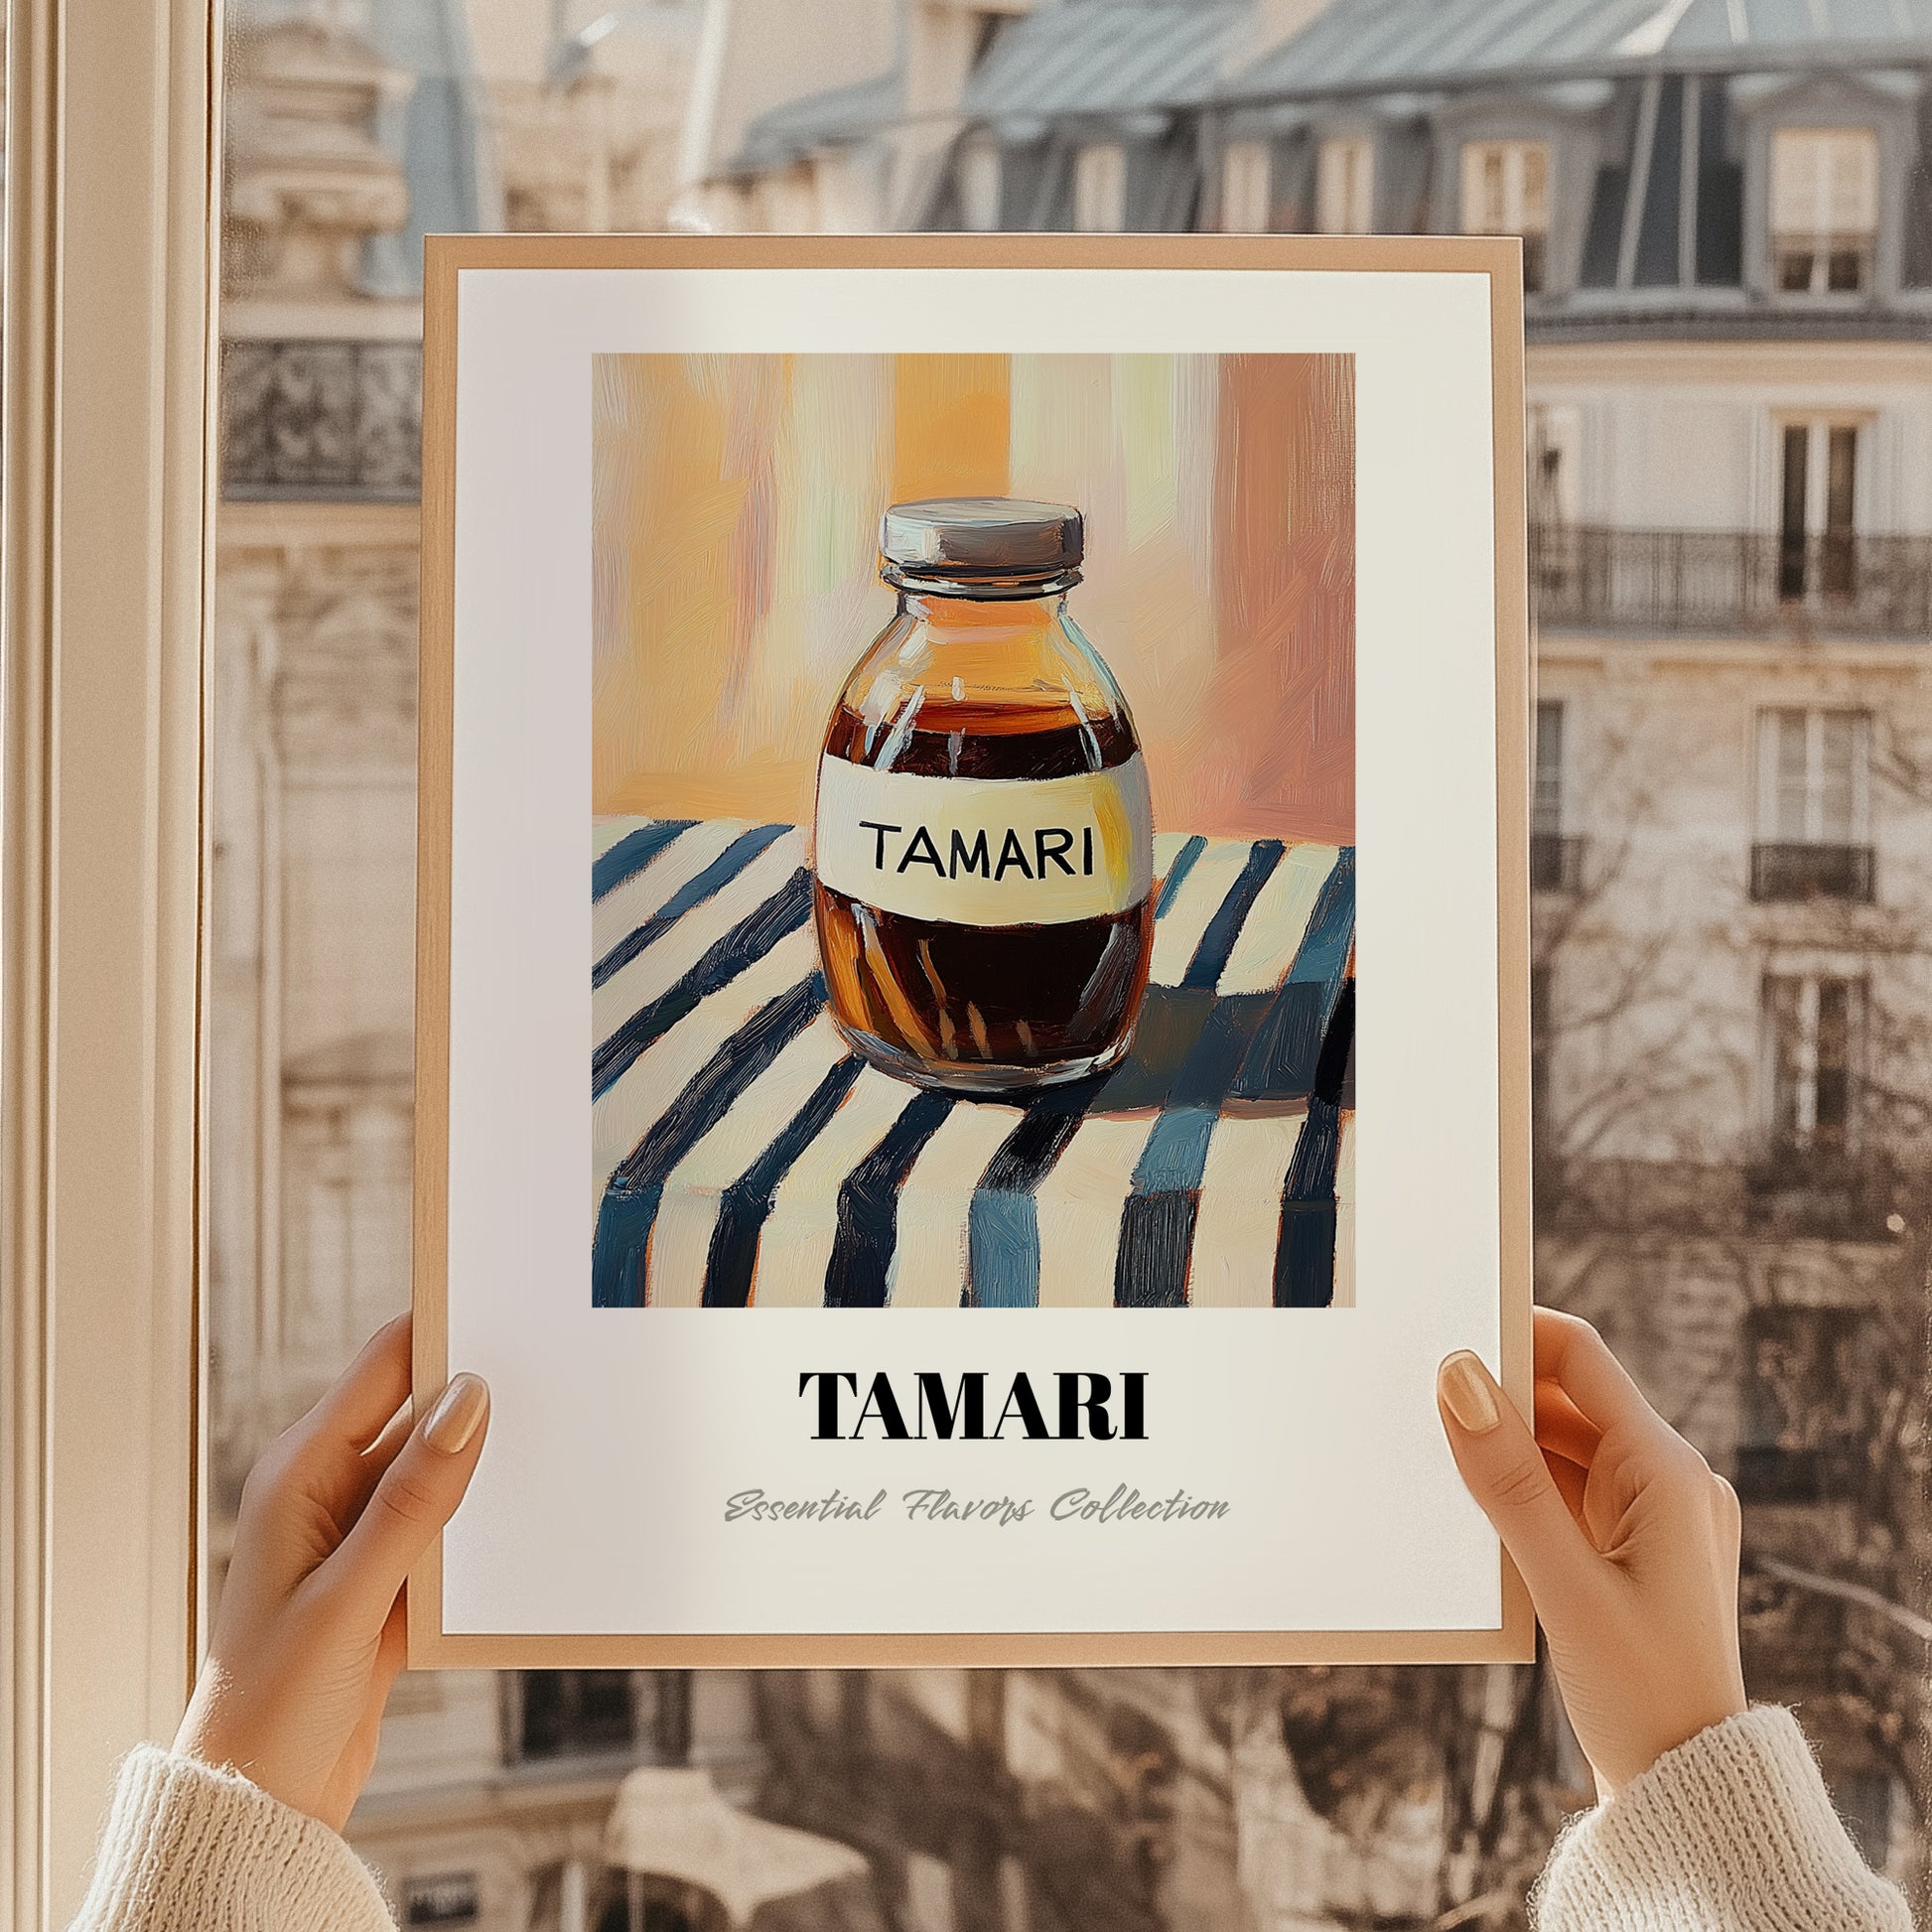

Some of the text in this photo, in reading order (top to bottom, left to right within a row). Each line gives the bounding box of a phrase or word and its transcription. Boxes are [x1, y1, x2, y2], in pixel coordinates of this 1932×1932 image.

[859, 820, 1093, 882] TAMARI
[798, 1371, 1150, 1441] TAMARI
[724, 1482, 1231, 1527] Essential Flavors Collection
